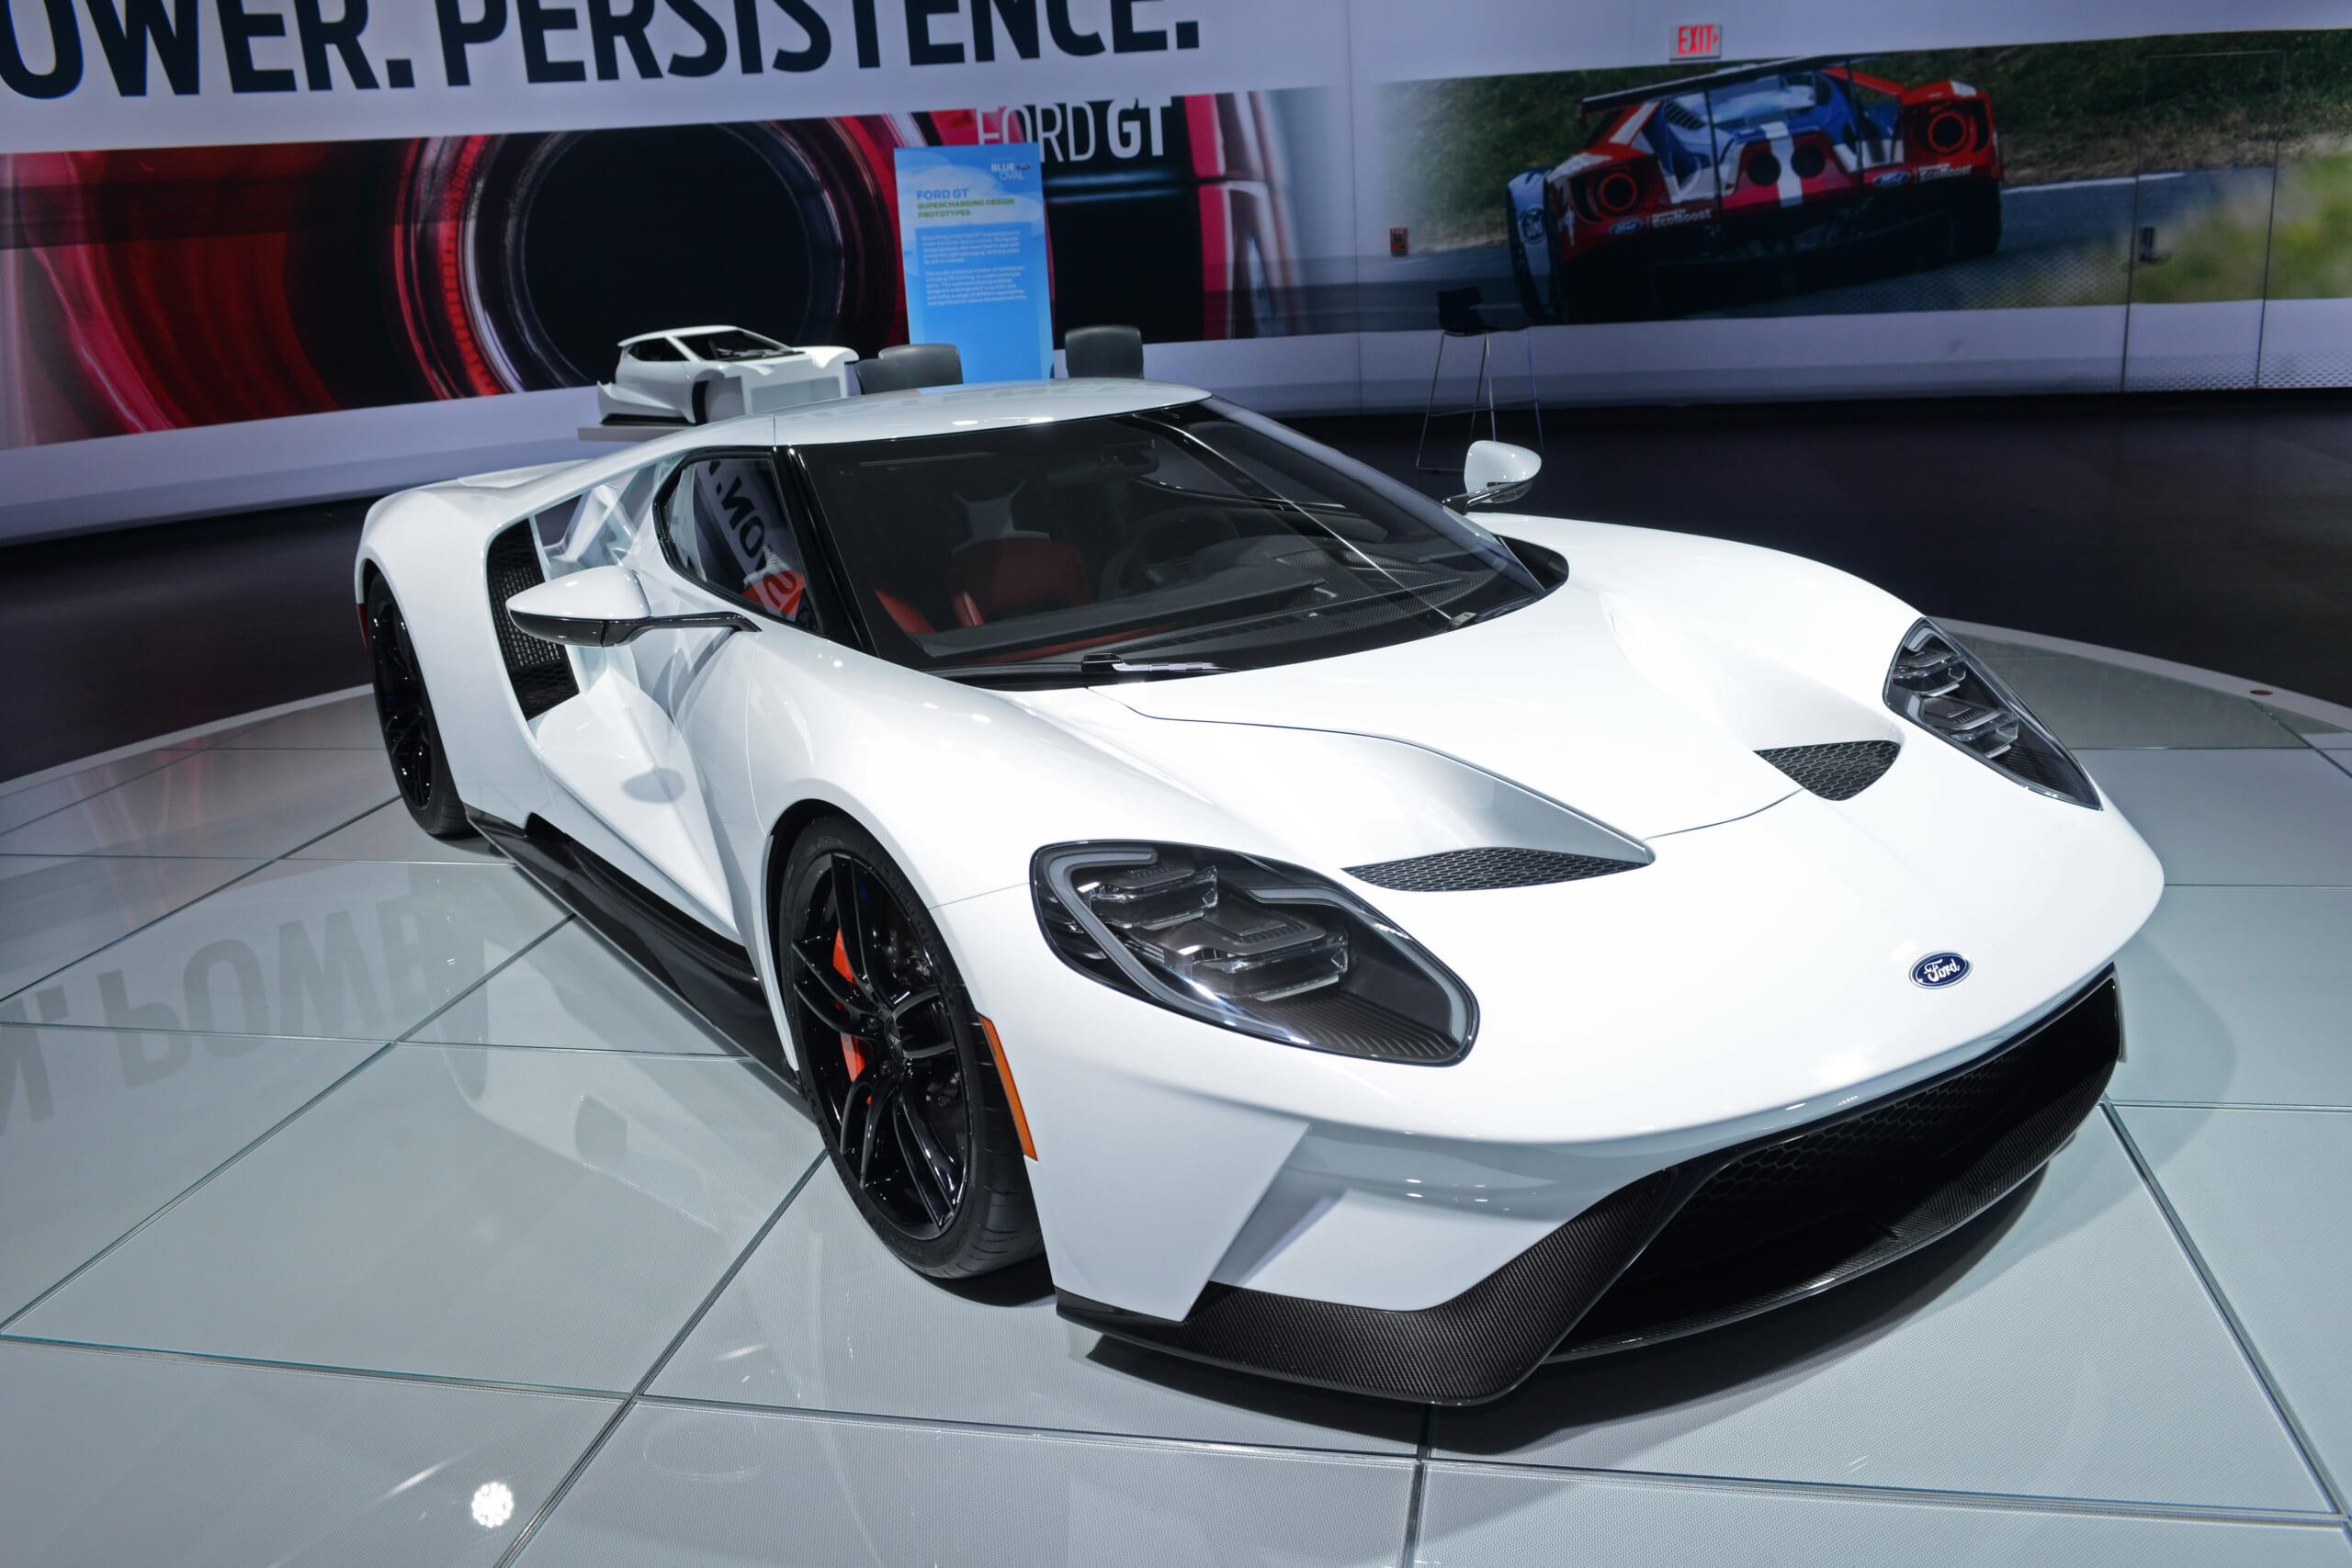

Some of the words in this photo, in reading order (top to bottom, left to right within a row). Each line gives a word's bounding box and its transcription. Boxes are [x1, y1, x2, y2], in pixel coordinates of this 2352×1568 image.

[1677, 23, 1714, 55] EXIT
[975, 100, 1097, 164] FORD
[1106, 96, 1172, 160] GT
[990, 162, 1015, 173] BLUE
[916, 189, 951, 200] FORD
[953, 187, 970, 199] GT
